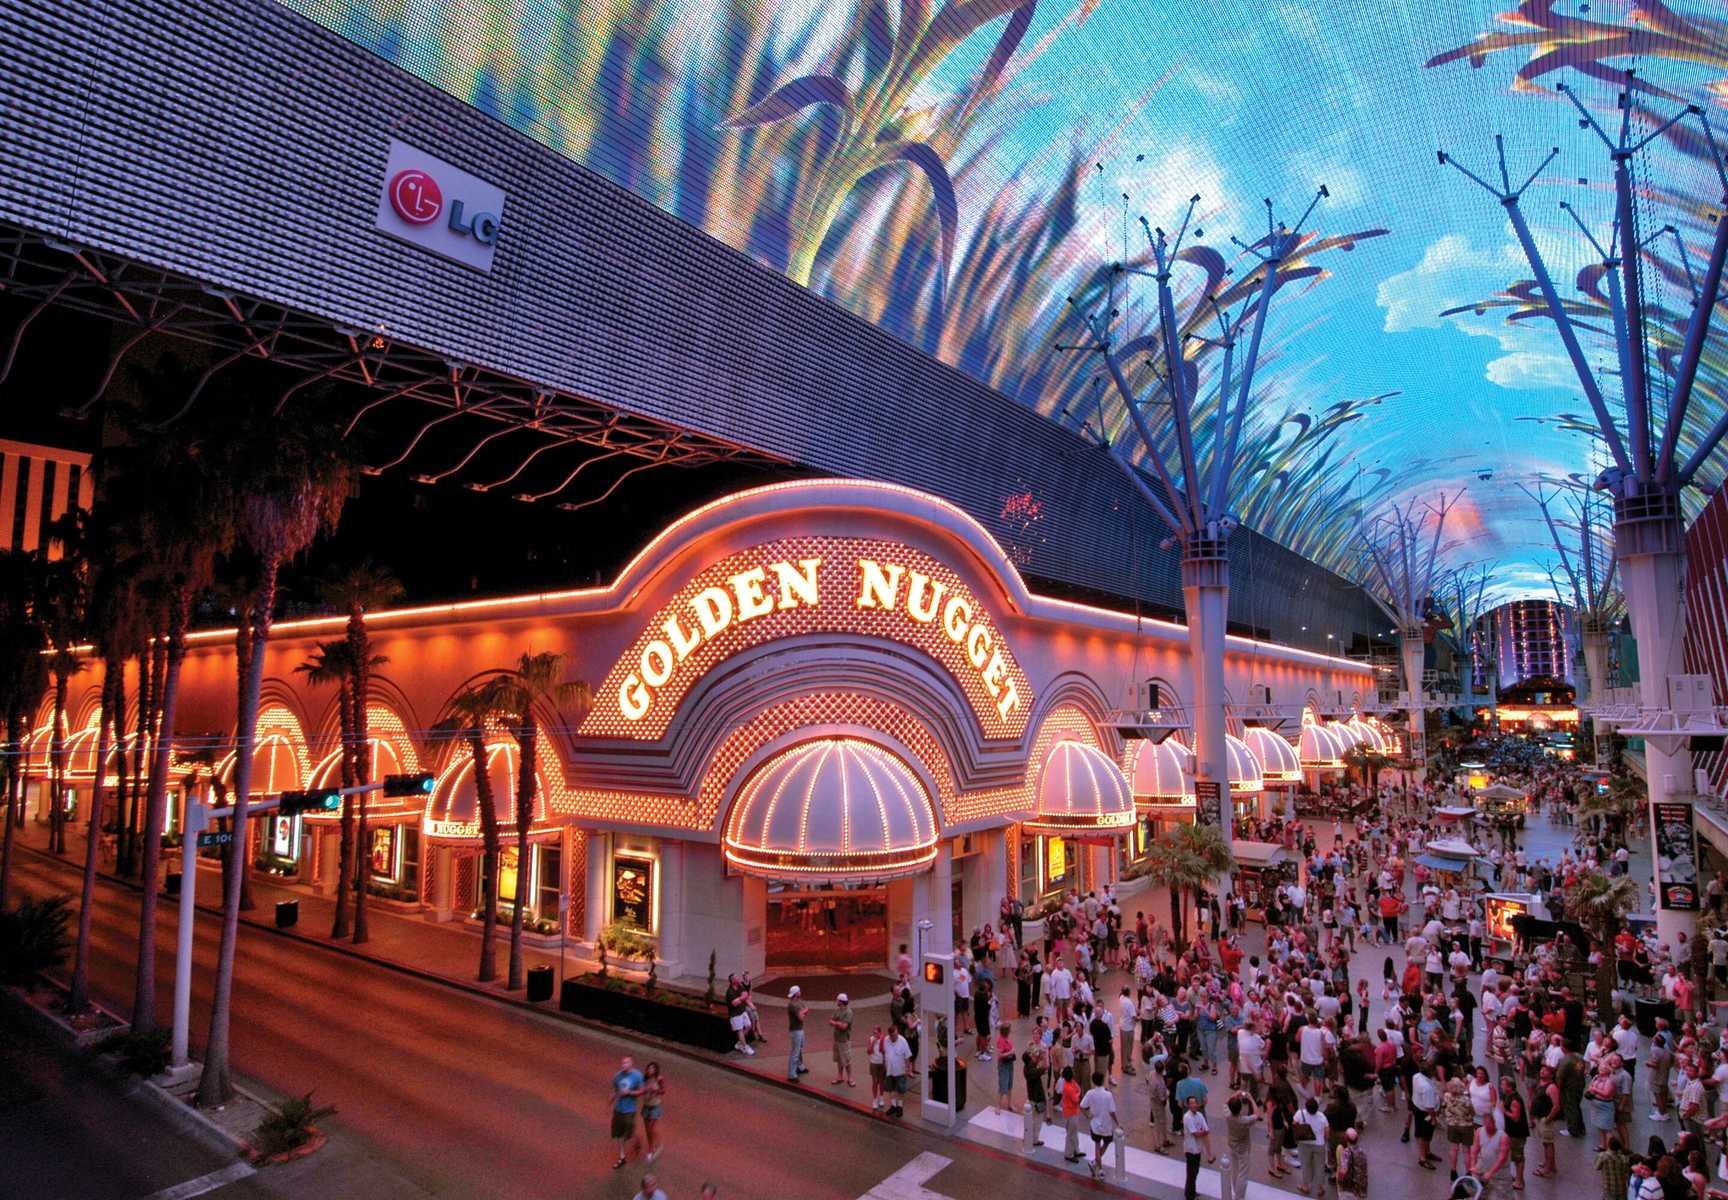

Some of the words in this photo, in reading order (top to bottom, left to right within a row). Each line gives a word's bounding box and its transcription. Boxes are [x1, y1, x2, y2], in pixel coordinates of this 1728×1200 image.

[448, 199, 500, 246] LG
[618, 557, 822, 721] GOLDEN
[857, 557, 1022, 723] NUGGET
[204, 835, 212, 845] E
